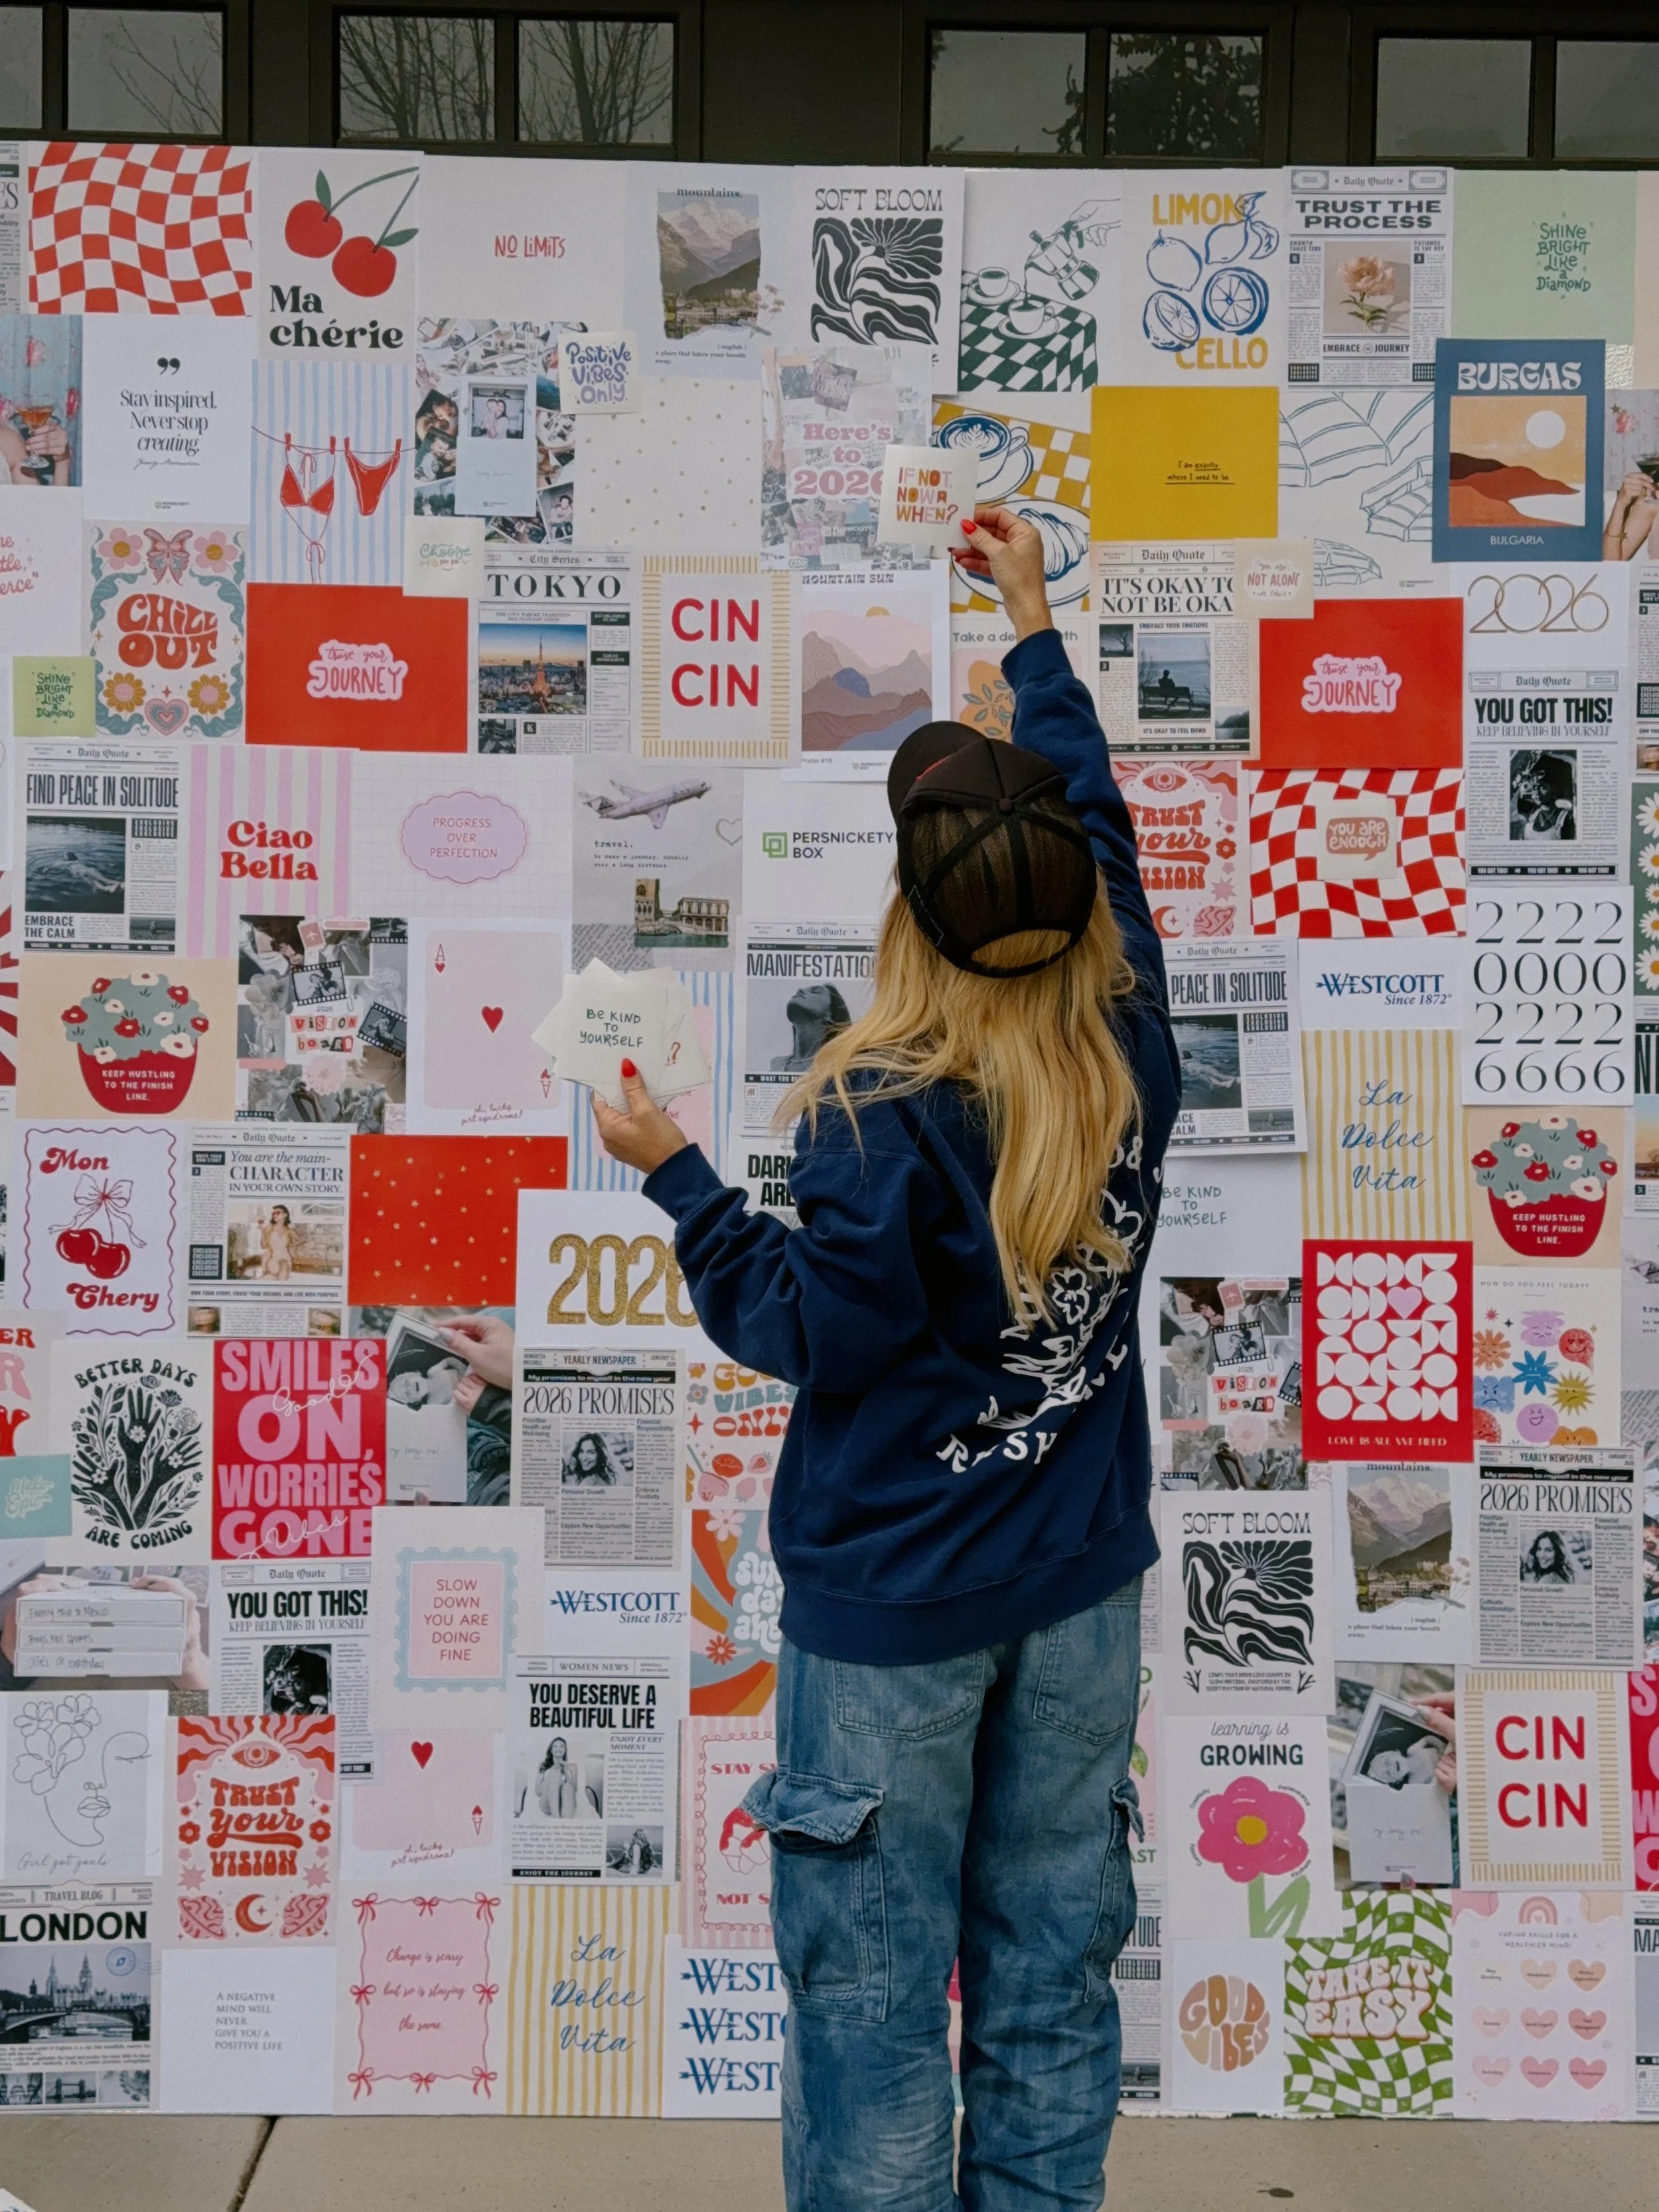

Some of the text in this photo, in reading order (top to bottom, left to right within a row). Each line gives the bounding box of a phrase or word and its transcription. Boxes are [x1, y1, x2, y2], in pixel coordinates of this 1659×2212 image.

[815, 188, 942, 211] SOFT BLOOM
[1152, 192, 1248, 226] LIMON
[1295, 200, 1441, 214] TRUST THE
[1305, 215, 1432, 229] PROCESS
[494, 235, 518, 259] NO
[269, 285, 323, 314] Ma
[269, 319, 403, 348] chérie
[1175, 336, 1268, 369] CELLO
[1323, 344, 1409, 352] EMBRACE JOURNEY
[1457, 362, 1581, 390] BURGAS
[120, 389, 217, 412] Stay inspired.
[581, 383, 625, 404] Only
[130, 411, 208, 435] Never stop
[137, 433, 200, 457] creating.
[899, 467, 915, 484] IF
[897, 487, 936, 504] NOW
[897, 504, 958, 525] WHEN?
[1490, 535, 1544, 546] BULGARIA
[1141, 550, 1205, 561] Daily Quote
[487, 574, 621, 598] TOKYO
[1104, 577, 1207, 595] IT'S OKAY
[1102, 596, 1181, 613] NOT BE
[1469, 573, 1609, 634] 2026
[671, 598, 759, 642] CIN
[118, 632, 218, 670] OUT
[325, 645, 388, 662] trust your
[312, 664, 403, 694] JOURNEY
[671, 664, 759, 707] CIN
[1475, 698, 1613, 724] YOU GOT THIS!
[1477, 725, 1611, 737] KEEP BELIEVING IN YOURSELF
[27, 774, 179, 808] FIND PEACE IN SOLITUDE
[433, 818, 491, 828] PROGRESS
[227, 821, 313, 849] Ciao
[447, 833, 476, 844] OVER
[793, 832, 893, 844] PERSNICKETY
[430, 848, 498, 858] PERFECTION
[793, 846, 824, 858] BOX
[220, 851, 319, 881] Bella
[25, 916, 74, 927] EMBRACE
[25, 928, 76, 939] THE CALM
[1321, 974, 1444, 995] WESTCOTT
[1385, 994, 1416, 1006] Since
[605, 1022, 618, 1032] TO
[610, 1011, 640, 1024] KIND
[1360, 1079, 1413, 1107] La
[1342, 1119, 1435, 1149] Dolce
[40, 1147, 109, 1174] Mon
[231, 1151, 251, 1163] You
[254, 1153, 273, 1163] are
[277, 1151, 293, 1163] the
[230, 1167, 344, 1181] CHARACTER
[1352, 1165, 1426, 1190] Vita
[230, 1184, 342, 1193] IN YOUR OWN STORY.
[67, 1283, 159, 1312] Chery
[220, 1341, 380, 1392] SMILES
[563, 1355, 636, 1366] YEARLY NEWSPAPER
[74, 1358, 198, 1388] BETTER DAYS
[524, 1386, 675, 1415] 2026 PROMISES
[238, 1394, 374, 1460] ON,
[218, 1463, 382, 1507] WORRIES
[85, 1520, 192, 1550] ARE COMING
[218, 1509, 372, 1556] GONE
[436, 1578, 477, 1591] SLOW
[433, 1596, 480, 1609] DOWN
[423, 1614, 489, 1626] YOU ARE
[431, 1632, 480, 1645] DOING
[440, 1649, 471, 1661] FINE
[560, 1662, 629, 1671] WOMEN NEWS
[530, 1684, 656, 1706] YOU DESERVE A
[530, 1707, 655, 1729] BEAUTIFUL LIFE
[1211, 1720, 1289, 1741] learning is
[1200, 1744, 1304, 1767] GROWING
[210, 1776, 299, 1806] TRUST
[207, 1808, 303, 1848] your
[210, 1850, 297, 1877] VISION
[44, 1889, 103, 1901] TRAVEL BLOG
[0, 1911, 148, 1942] LONDON
[1304, 1955, 1435, 2003] TAKE IT
[226, 1993, 276, 2002] NEGATIVE
[216, 2004, 271, 2014] MIND WILL
[1307, 1990, 1431, 2041] EASY
[216, 2017, 248, 2026] NEVER
[215, 2029, 238, 2037] GIVE
[240, 2029, 261, 2038] YOU
[215, 2041, 283, 2050] POSITIVE LIFE
